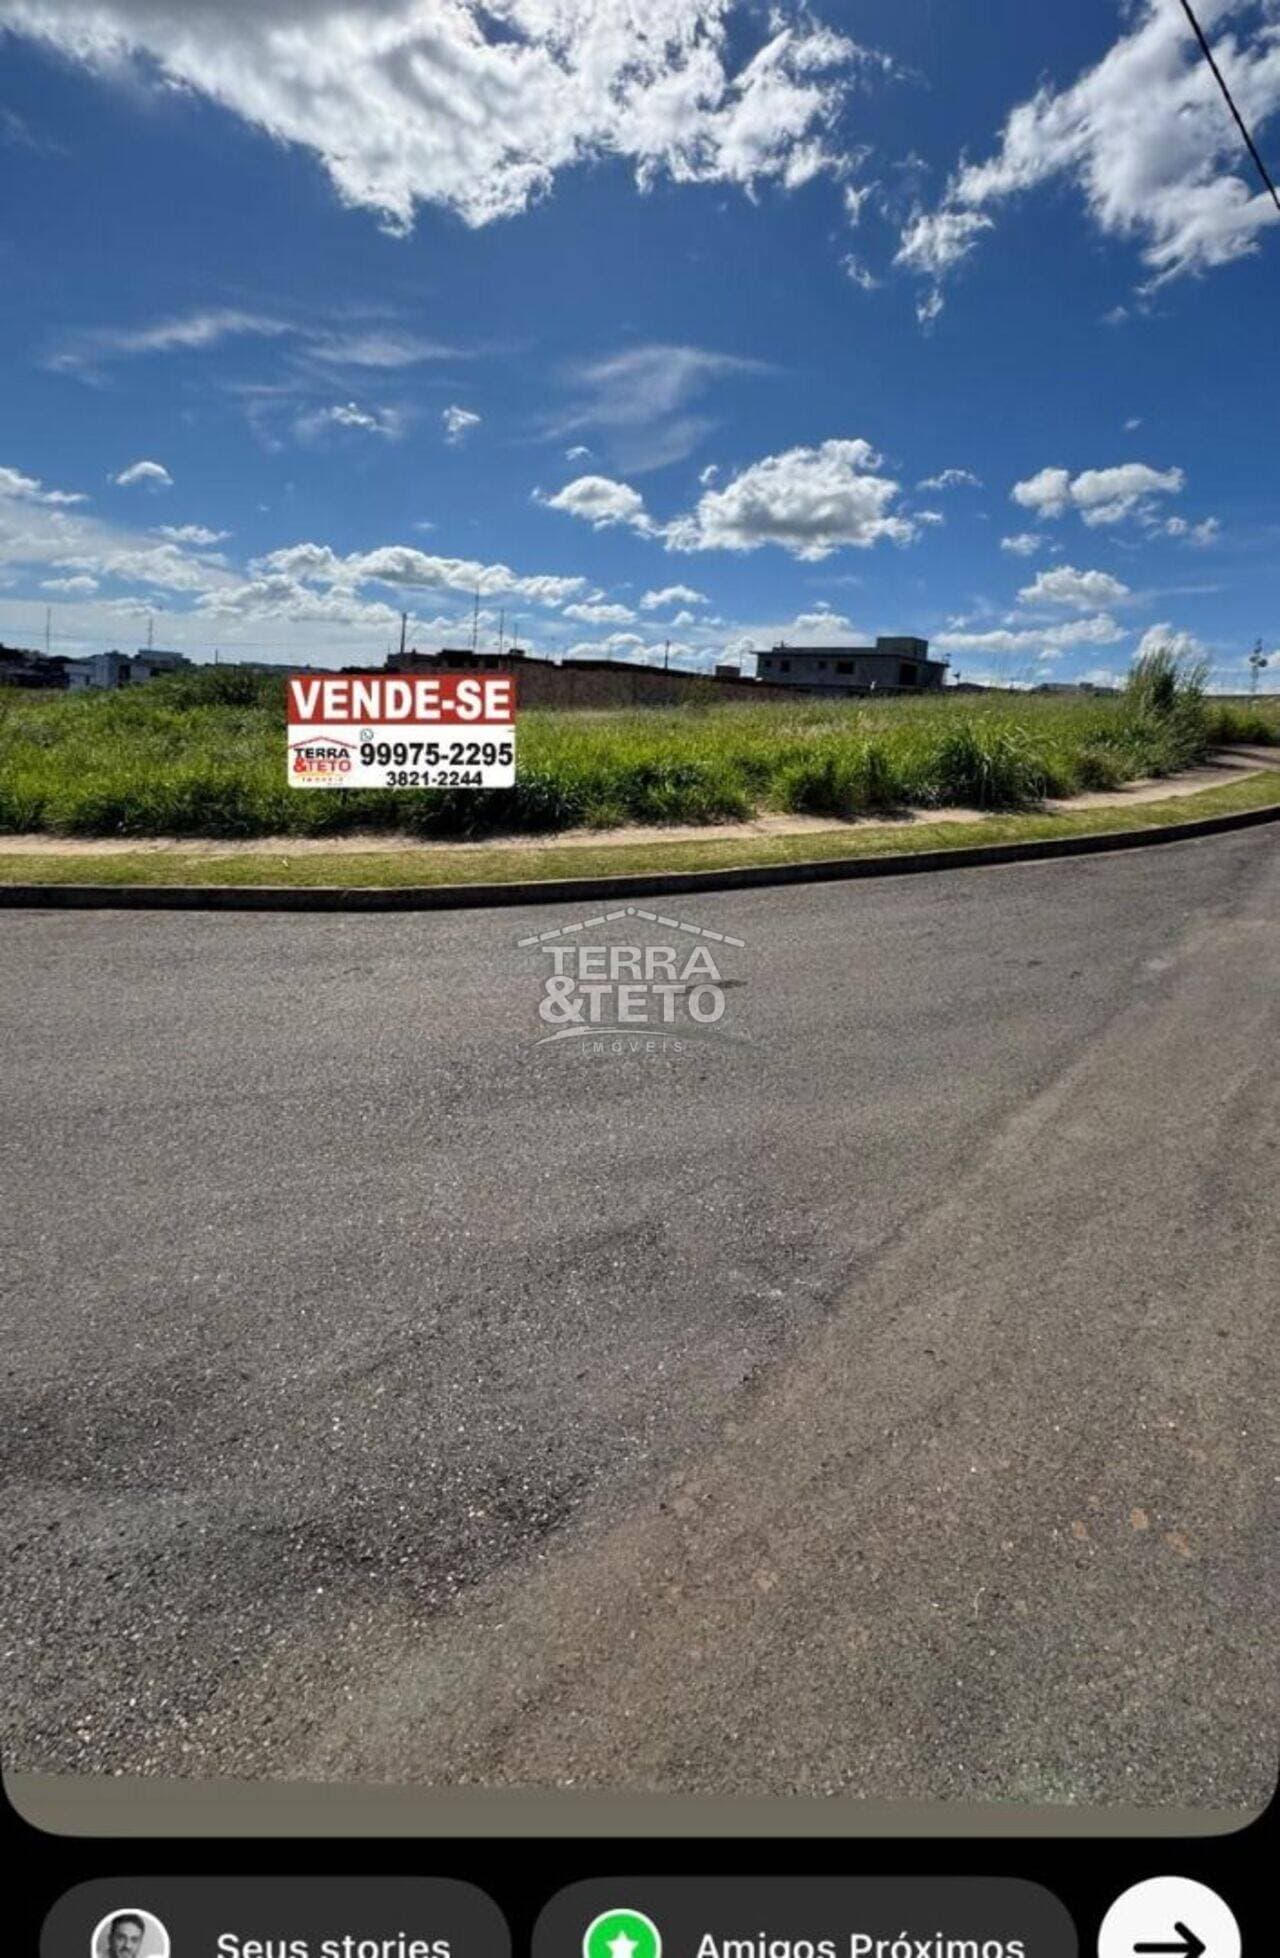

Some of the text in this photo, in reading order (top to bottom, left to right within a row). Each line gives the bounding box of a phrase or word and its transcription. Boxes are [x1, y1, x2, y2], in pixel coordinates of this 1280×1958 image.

[290, 679, 511, 720] VENDE-SE
[293, 747, 350, 759] TERRA
[360, 742, 513, 766] 99975-2295
[386, 771, 483, 787] 3821-2244
